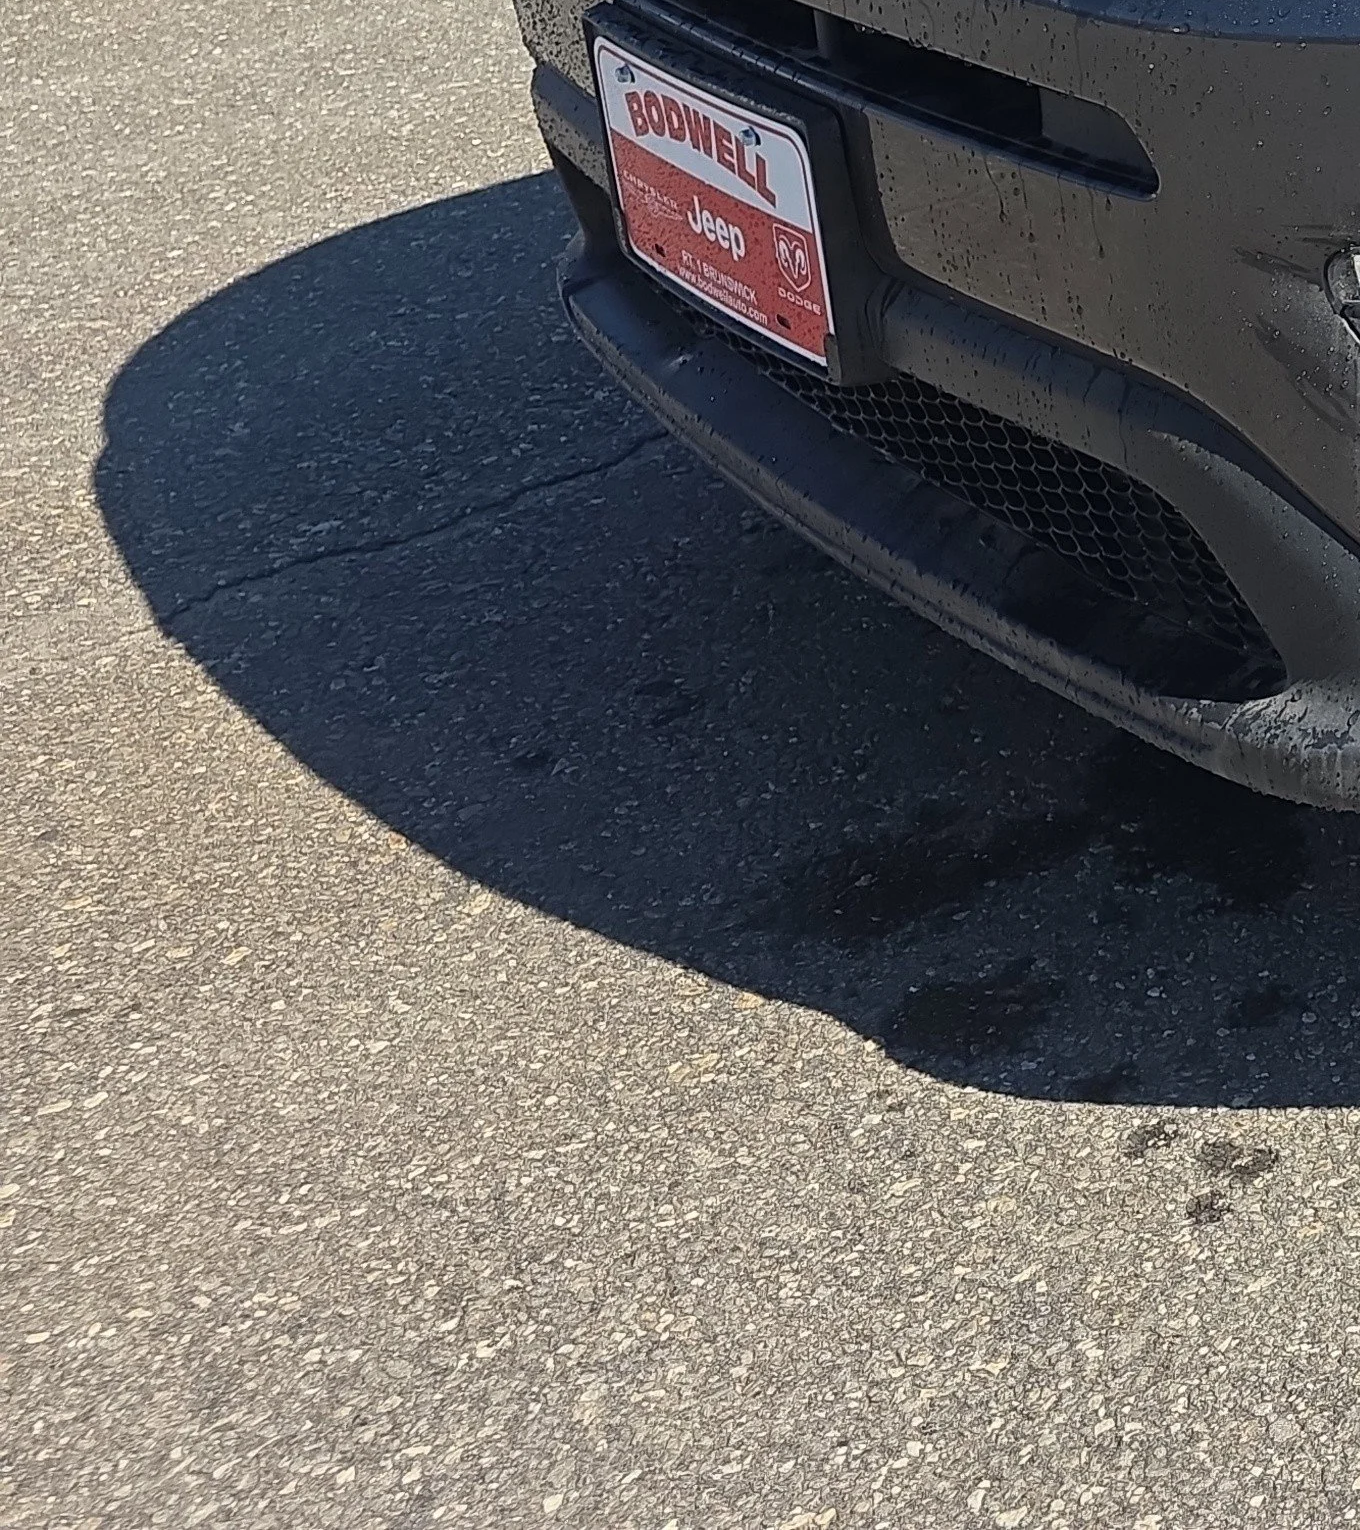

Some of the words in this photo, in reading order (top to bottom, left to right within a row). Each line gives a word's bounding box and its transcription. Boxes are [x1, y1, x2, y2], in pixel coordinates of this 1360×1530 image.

[624, 89, 778, 209] BODWELL
[623, 171, 680, 210] CHRYSLER
[687, 195, 746, 261] Jeep
[702, 263, 758, 306] BRUNSWICK
[778, 287, 822, 317] DODGE
